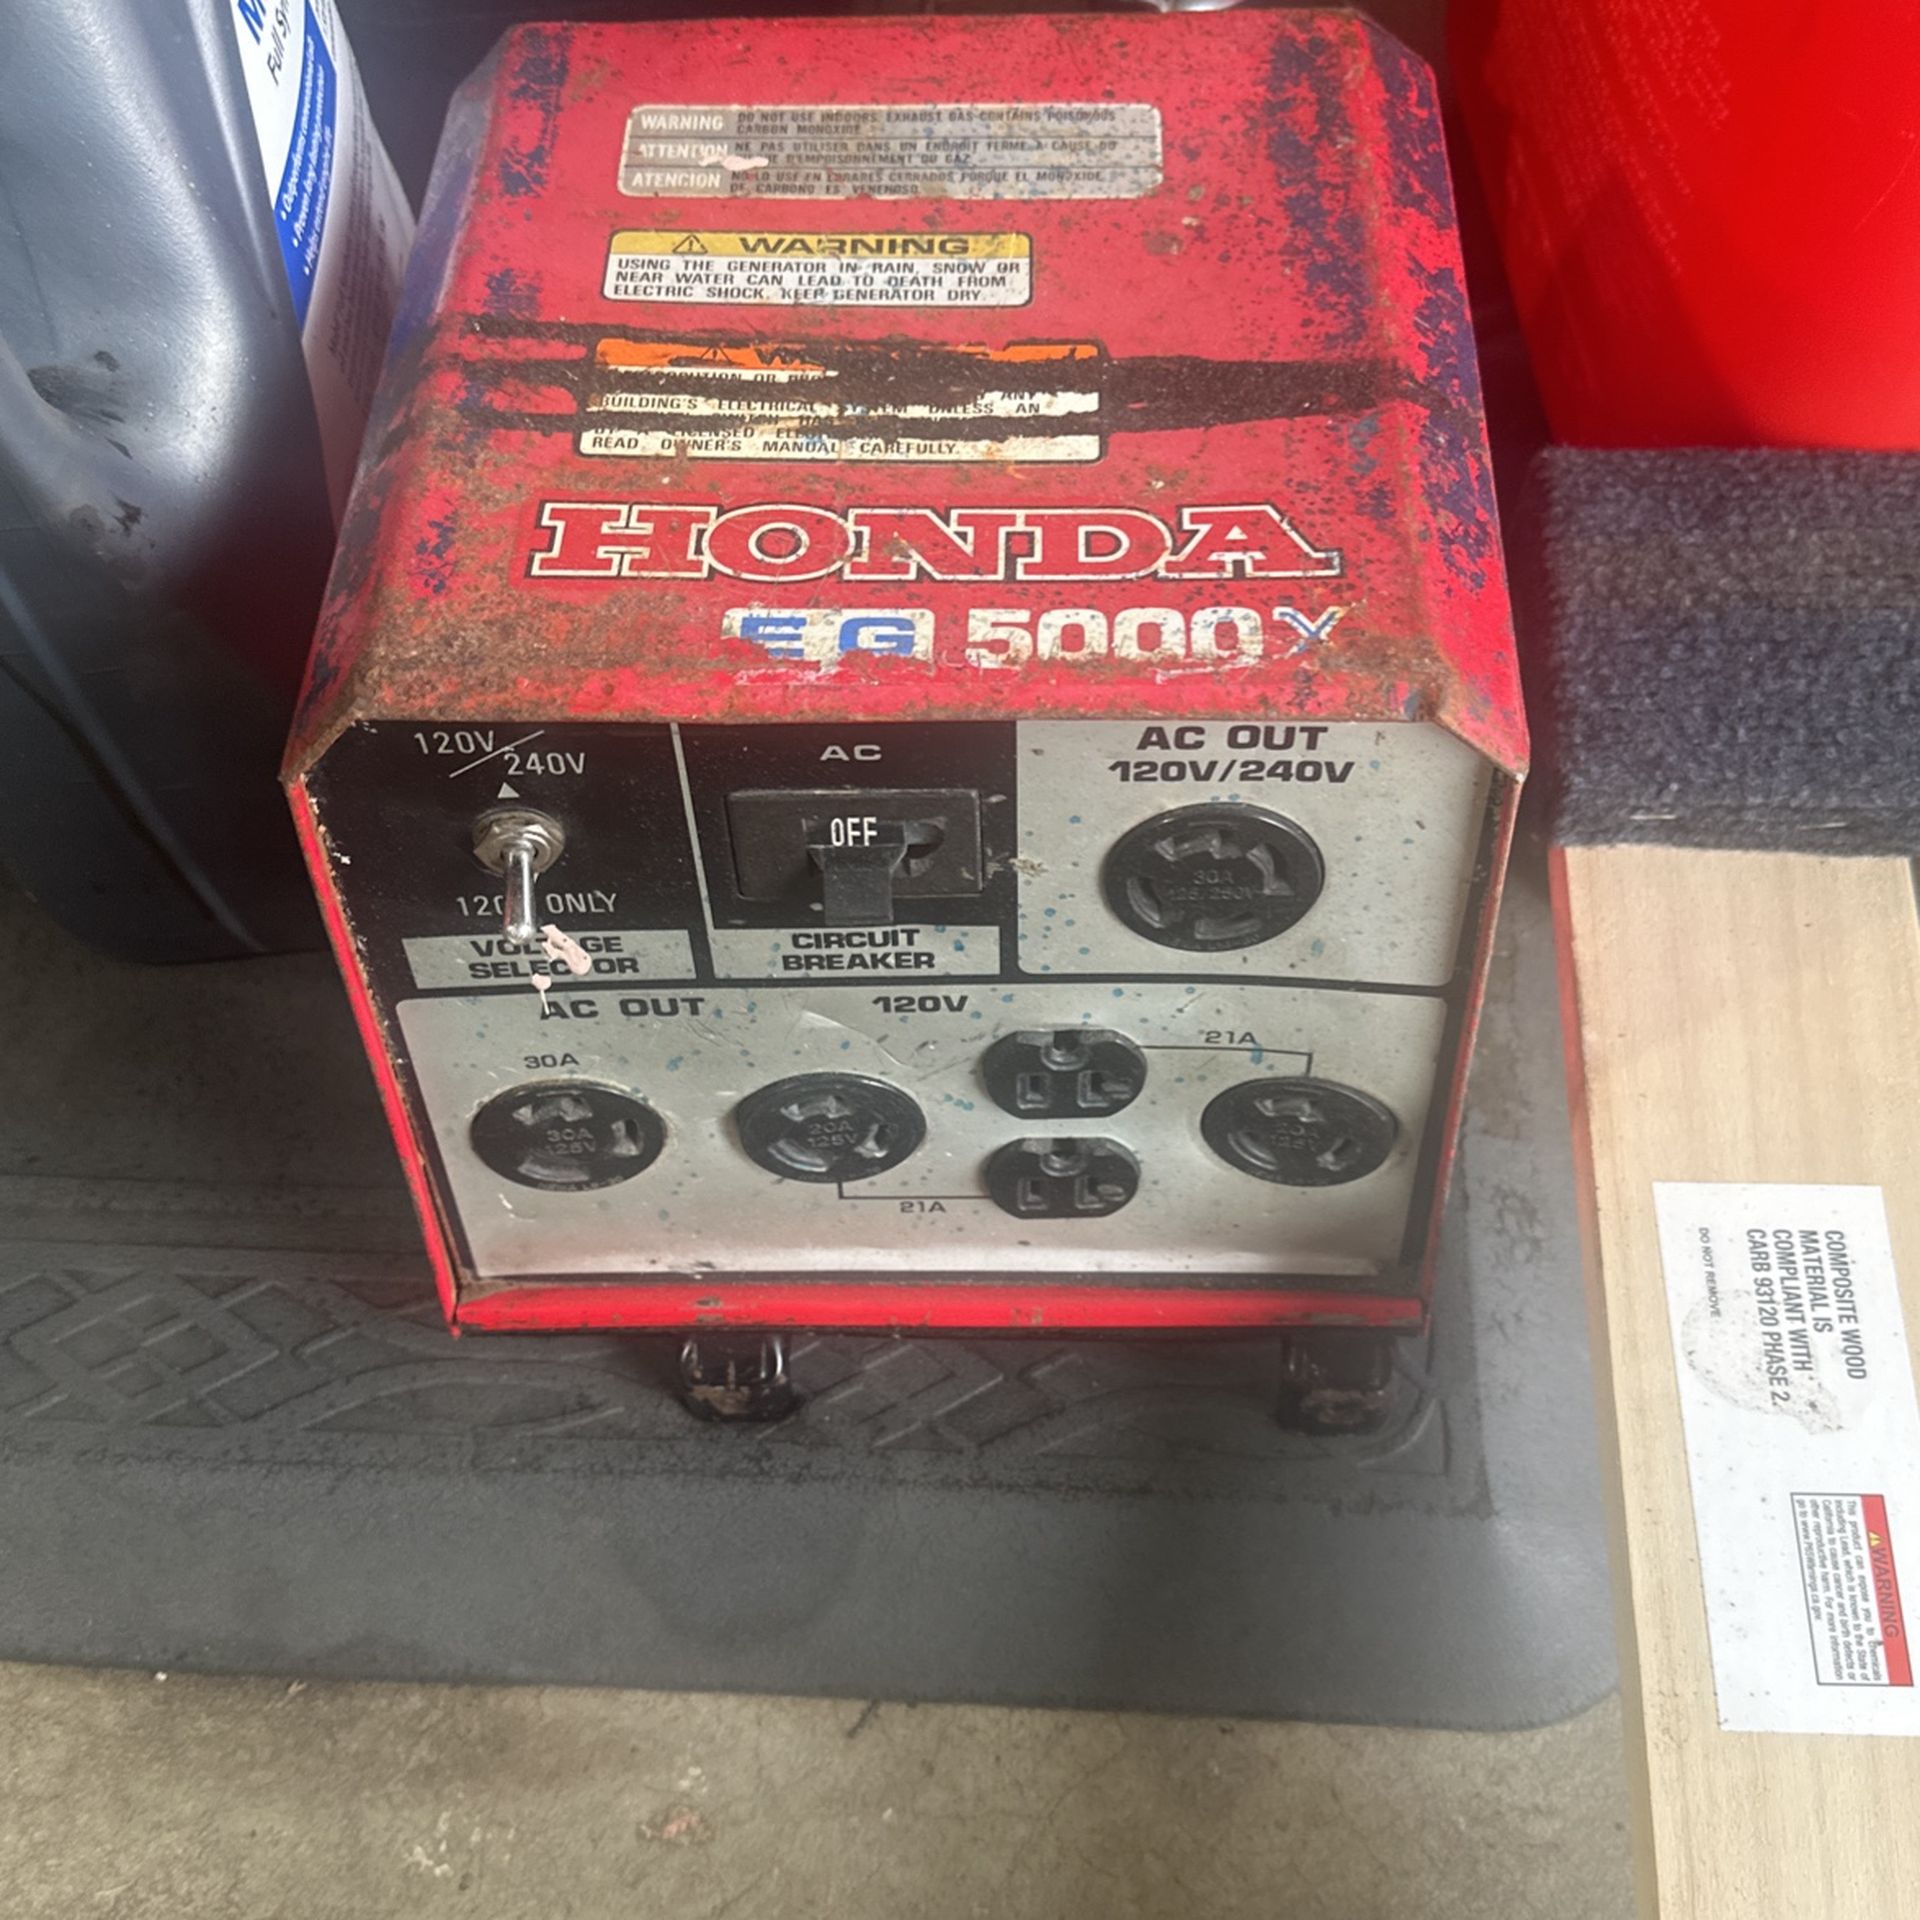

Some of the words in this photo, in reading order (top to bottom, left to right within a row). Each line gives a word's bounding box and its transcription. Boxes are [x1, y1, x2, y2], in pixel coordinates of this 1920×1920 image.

[267, 24, 285, 86] Full
[641, 114, 723, 131] WARNING
[738, 112, 755, 122] DO
[761, 113, 784, 122] NOT
[792, 113, 816, 122] USE
[886, 112, 942, 122] EXHAUST
[949, 111, 973, 122] GAS
[736, 124, 788, 135] CARBON
[639, 144, 728, 160] ATTENTION
[735, 142, 753, 151] NE
[761, 142, 785, 152] PAS
[792, 142, 851, 152] UTILISER
[856, 142, 892, 152] DANS
[921, 154, 938, 164] DU
[632, 173, 721, 188] ATENCION
[777, 172, 799, 182] USE
[804, 172, 822, 182] EN
[756, 184, 815, 194] CARBONO
[825, 184, 841, 194] ES
[739, 236, 969, 255] WARNING
[618, 259, 670, 270] USING
[684, 260, 714, 271] THE
[728, 261, 826, 272] GENERATOR
[933, 262, 986, 273] SNOW
[997, 262, 1020, 273] OR
[616, 272, 663, 283] NEAR
[675, 273, 734, 284] WATER
[746, 274, 783, 285] CAN
[799, 275, 841, 286] LEAD
[854, 276, 874, 286] TO
[887, 276, 943, 286] DEATH
[958, 276, 1006, 286] FROM
[614, 285, 693, 297] ELECTRIC
[834, 289, 934, 300] GENERATOR
[1015, 403, 1040, 414] AN
[592, 436, 639, 449] READ
[762, 441, 839, 454] MANUAL
[531, 503, 1343, 579] HONDA
[721, 607, 935, 662] EG
[413, 730, 496, 756] 120V
[1136, 725, 1205, 750] AC
[1227, 725, 1328, 751] OUT
[504, 750, 587, 776] 240V
[820, 745, 882, 762] AC
[1108, 759, 1355, 784] 120V/240V
[829, 817, 878, 847] OFF
[546, 892, 617, 914] ONLY
[470, 936, 623, 957] VOLGE
[791, 929, 920, 950] CIRCUIT
[469, 957, 640, 979] SELECOR
[782, 952, 935, 972] BREAKER
[540, 999, 599, 1020] AC
[620, 997, 705, 1017] OUT
[873, 995, 969, 1013] 120V
[1205, 1030, 1258, 1046] 21A
[524, 1053, 580, 1068] 30A
[546, 1128, 594, 1143] 30A
[808, 1120, 853, 1135] 20A
[900, 1201, 946, 1214] 21A
[1699, 1227, 1710, 1244] DO
[1701, 1246, 1714, 1268] NOT
[1747, 1228, 1771, 1272] CARB
[1773, 1229, 1806, 1323] COMPLIANT
[1798, 1230, 1830, 1312] MATERIAL
[1705, 1271, 1721, 1318] REMOVE
[1754, 1277, 1779, 1327] 93120
[1824, 1230, 1858, 1324] COMPOSITE
[1841, 1329, 1867, 1380] WOOD
[1812, 1317, 1834, 1333] IS
[1762, 1331, 1789, 1387] PHASE
[1788, 1329, 1813, 1371] WITH
[1771, 1391, 1790, 1407] 2.
[1796, 1499, 1807, 1509] go
[1809, 1499, 1822, 1519] other
[1847, 1500, 1857, 1516] This
[1822, 1500, 1835, 1535] California
[1813, 1521, 1828, 1569] reproductive
[1828, 1537, 1837, 1545] to
[1848, 1521, 1862, 1550] product
[1829, 1548, 1839, 1571] cause
[1855, 1555, 1865, 1570] can
[1843, 1560, 1855, 1583] which
[1832, 1573, 1844, 1599] cancer
[1857, 1575, 1870, 1602] expose
[1872, 1548, 1899, 1638] WARNING
[1824, 1597, 1834, 1609] For
[1837, 1602, 1848, 1617] and
[1848, 1594, 1860, 1621] known
[1827, 1612, 1838, 1633] more
[1862, 1608, 1873, 1622] you
[1840, 1619, 1851, 1638] birth
[1853, 1624, 1862, 1632] to
[1866, 1628, 1876, 1636] to
[1854, 1634, 1865, 1647] the
[1830, 1636, 1844, 1680] information
[1843, 1641, 1855, 1669] defects
[1857, 1649, 1868, 1670] State
[1868, 1641, 1882, 1681] chemicals
[1847, 1672, 1855, 1681] or
[1860, 1673, 1870, 1681] of
